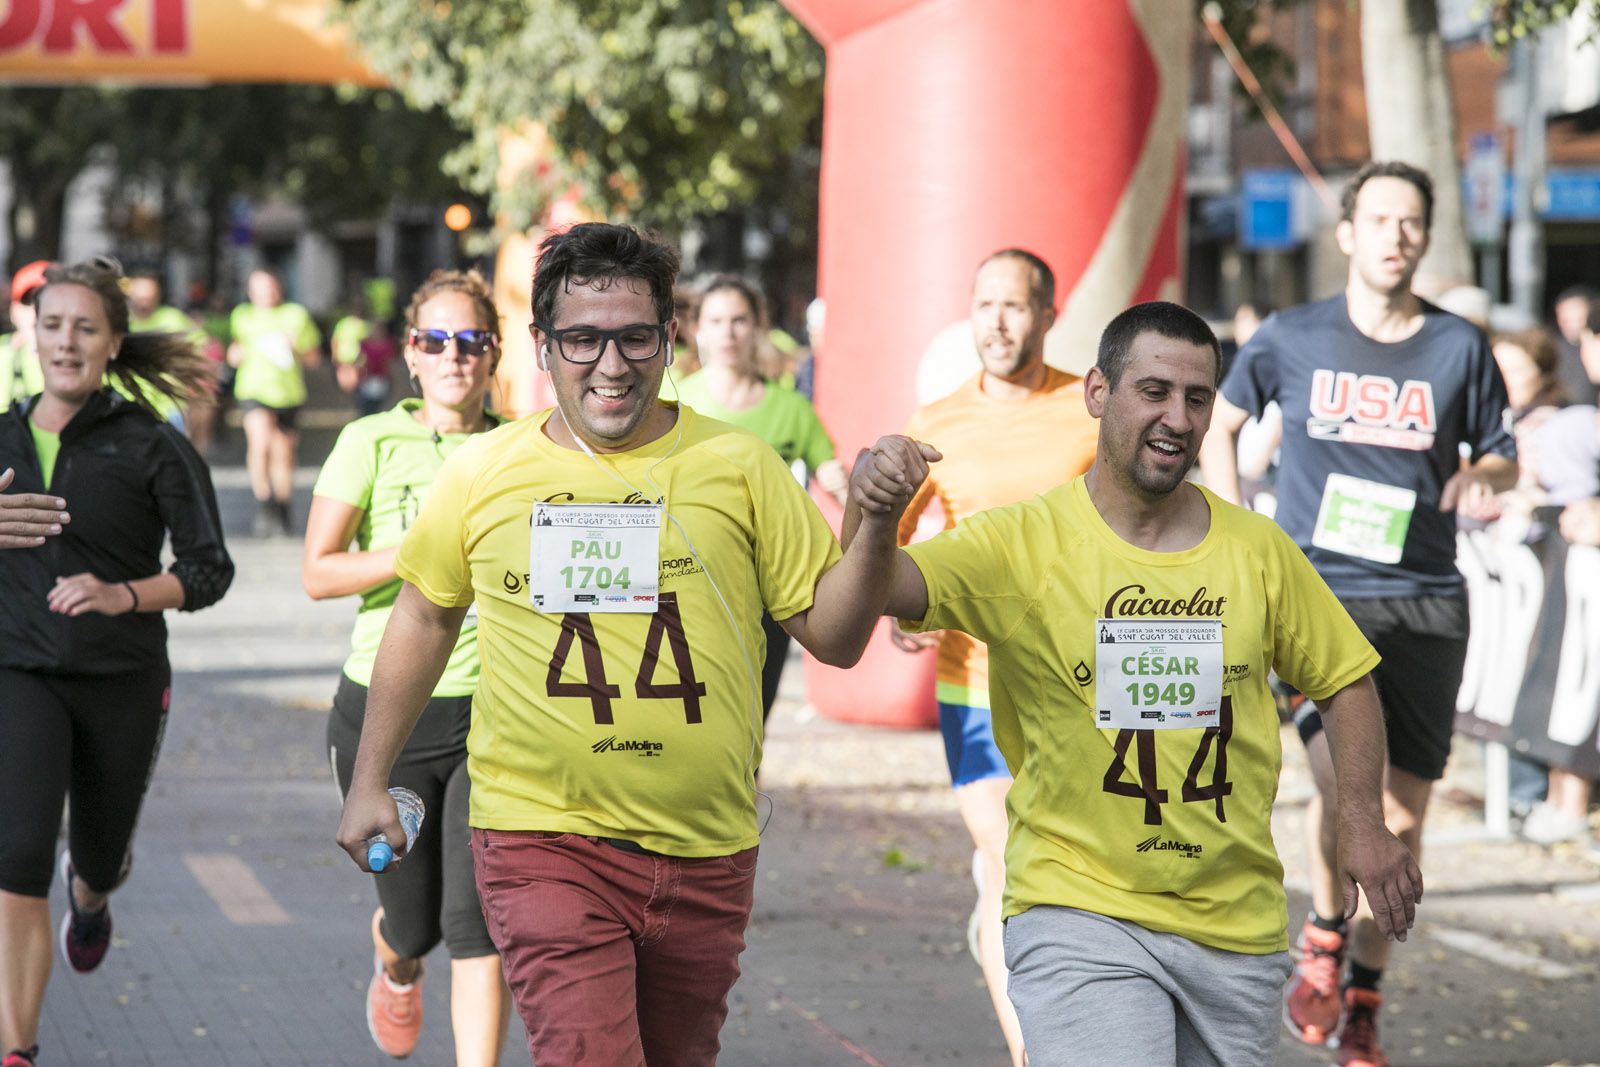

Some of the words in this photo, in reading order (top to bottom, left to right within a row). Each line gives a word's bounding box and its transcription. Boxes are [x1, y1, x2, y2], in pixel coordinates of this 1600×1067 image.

[1312, 370, 1435, 432] USA
[570, 540, 622, 560] PAU
[662, 557, 693, 569] ROMA
[560, 566, 631, 589] 1704
[1104, 584, 1227, 619] Cacaolat
[546, 591, 706, 725] 44
[1121, 651, 1200, 675] CÉSAR
[1126, 682, 1196, 706] 1949
[1196, 709, 1216, 717] SPORT
[1103, 695, 1233, 825] 44
